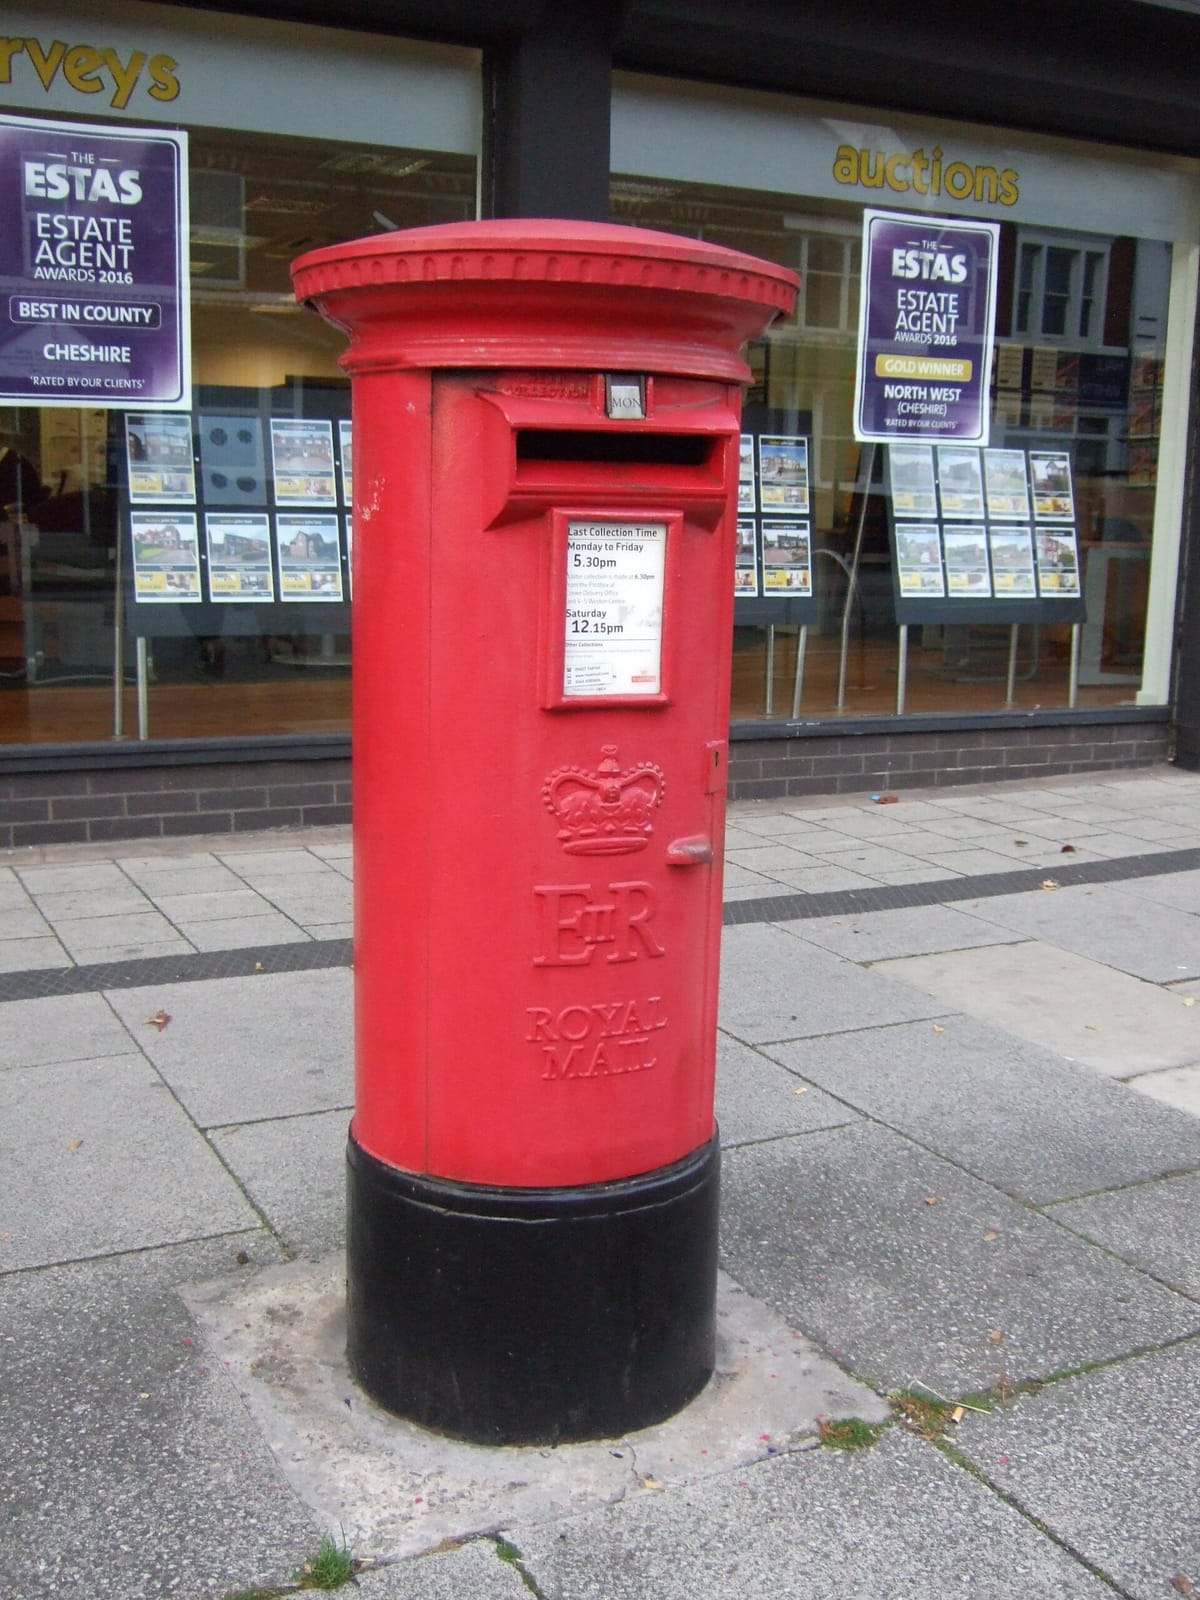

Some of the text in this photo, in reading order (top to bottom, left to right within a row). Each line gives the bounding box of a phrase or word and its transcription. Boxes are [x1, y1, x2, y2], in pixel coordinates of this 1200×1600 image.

[0, 36, 180, 110] rveys
[71, 151, 95, 164] THE
[25, 161, 142, 205] ESTAS
[833, 145, 1019, 206] auctions
[37, 212, 132, 244] ESTATE
[922, 240, 937, 250] THE
[35, 239, 135, 269] AGENT
[892, 248, 967, 283] ESTAS
[34, 266, 133, 284] AWARDS 2016
[897, 289, 958, 313] ESTATE
[19, 301, 152, 323] BEST IN COUNTY
[895, 310, 959, 333] AGENT
[894, 331, 957, 346] AWARDS 2016
[43, 343, 131, 363] CHESHIRE
[885, 359, 964, 376] GOLD WINNER
[68, 378, 79, 387] BY
[81, 378, 102, 387] OUR
[884, 385, 962, 401] NORTH WEST
[612, 397, 641, 408] MON
[897, 402, 947, 416] (CHESHIRE)
[568, 528, 657, 537] Last Collection Time
[567, 542, 644, 553] Monday to Friday
[574, 554, 617, 569] 5.30pm
[566, 609, 607, 619] Saturday
[572, 620, 624, 635] 12.15pm
[526, 996, 668, 1042] ROYAL
[541, 1037, 656, 1081] MAIL
